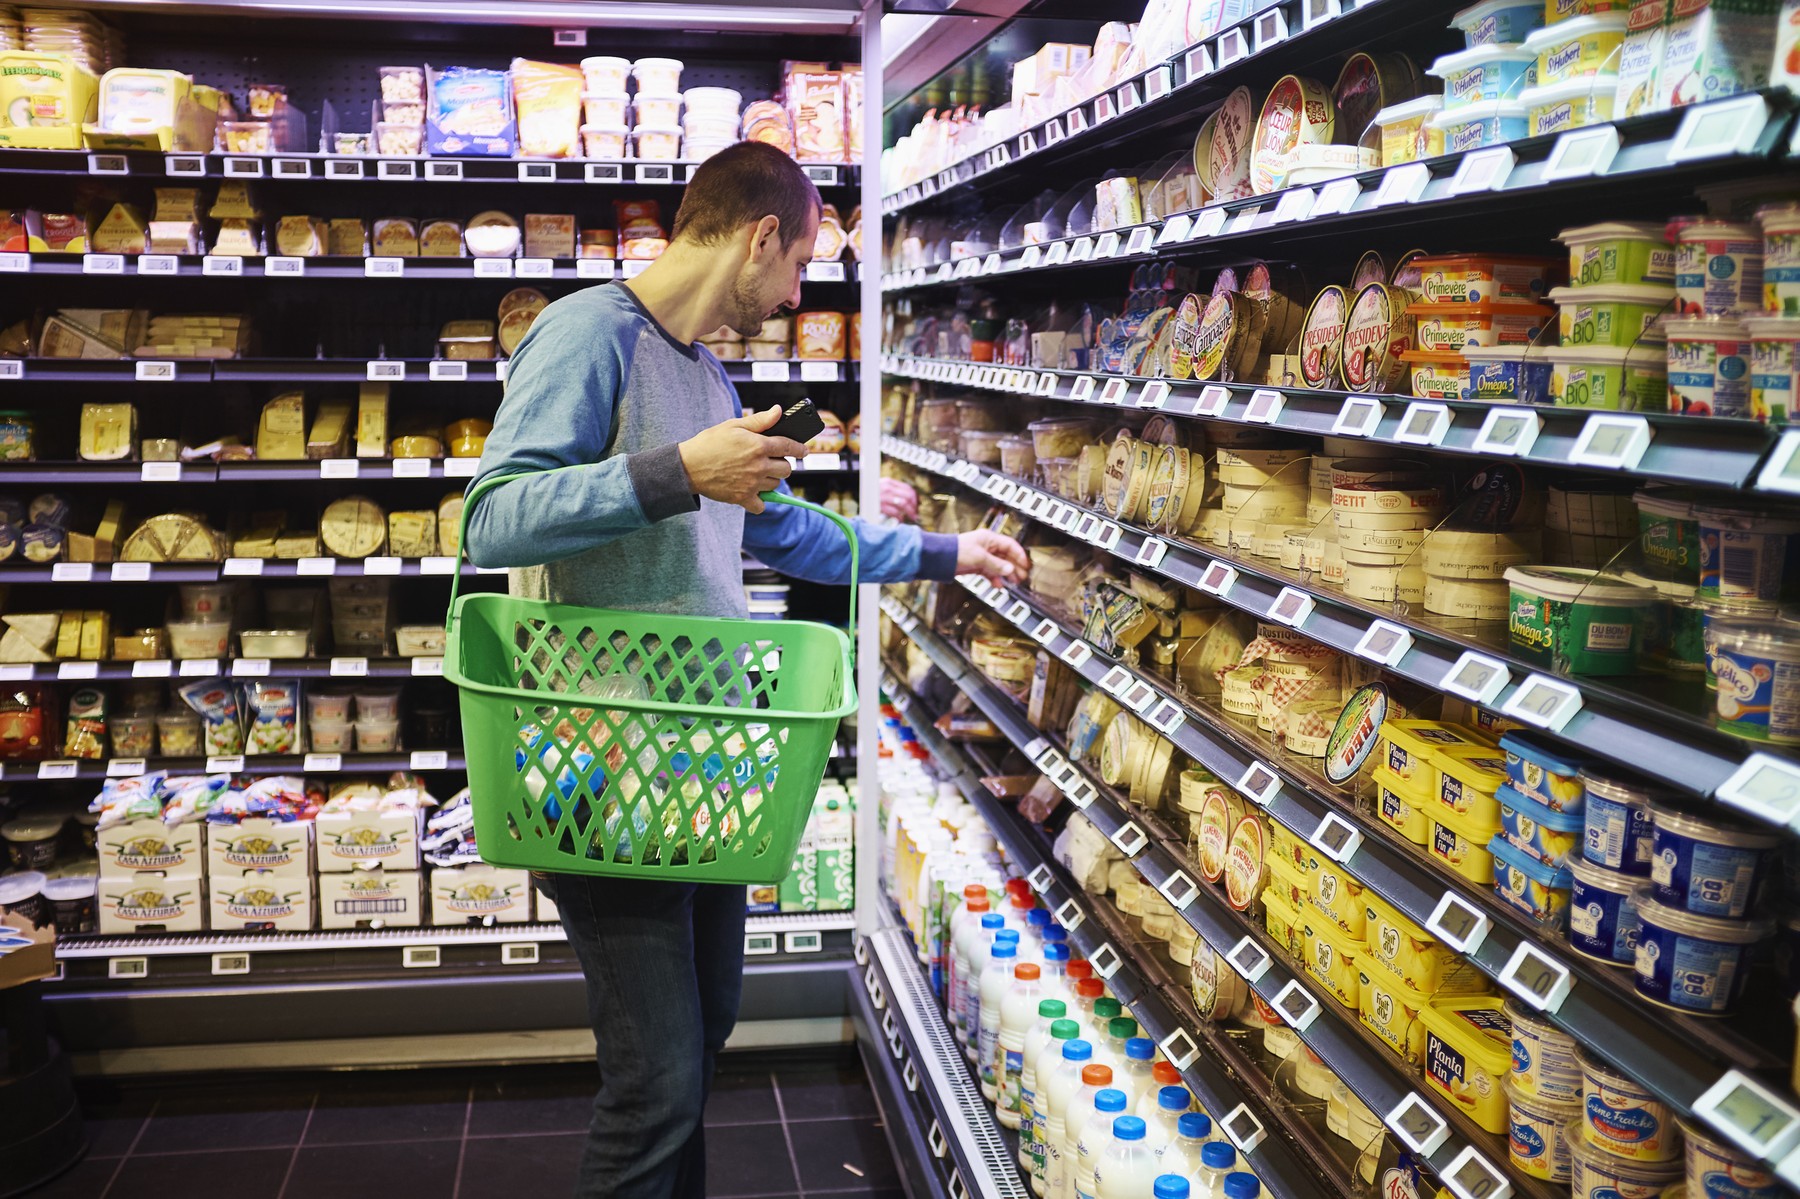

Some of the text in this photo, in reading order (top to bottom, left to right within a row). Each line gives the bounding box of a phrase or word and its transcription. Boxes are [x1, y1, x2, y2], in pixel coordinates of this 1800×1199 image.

[1582, 260, 1602, 285] BIO
[1427, 280, 1467, 296] Primevère
[1303, 323, 1344, 350] PRÉSIDENT
[1344, 322, 1389, 351] PRÉSIDENT
[1425, 328, 1465, 344] Primevère
[1573, 321, 1595, 343] BIO
[1353, 353, 1361, 369] 8
[1418, 375, 1459, 392] Primevère
[1477, 374, 1515, 395] Oméga 3
[1566, 383, 1589, 405] BIO
[0, 425, 26, 436] alakis
[1332, 493, 1367, 508] LEPETIT
[1510, 611, 1553, 648] Oméga 3
[1480, 713, 1491, 725] Fin
[1389, 742, 1407, 765] Planta
[1391, 758, 1401, 771] Fin
[1442, 774, 1462, 796] Planta
[1383, 789, 1400, 811] Planta
[1444, 789, 1454, 803] Fin
[1384, 804, 1393, 817] Fin
[1435, 823, 1456, 846] Planta
[335, 844, 398, 855] CASA AZZURRA
[1437, 839, 1447, 854] Fin
[118, 854, 182, 866] CASA AZZURRA
[226, 853, 289, 865] CASA AZZURRA
[1233, 846, 1256, 877] CAMEMBERT
[1322, 874, 1334, 890] Fruit
[1321, 888, 1332, 901] d'Or
[118, 906, 181, 917] CASA AZZURRA
[228, 905, 291, 916] CASA AZZURRA
[1382, 927, 1396, 943] Fruit
[1318, 943, 1330, 958] Fruit
[1382, 942, 1394, 956] d'Or
[1318, 956, 1329, 970] d'Or
[1192, 958, 1217, 988] PRÉSIDENT
[1532, 971, 1552, 995] 0
[1376, 992, 1389, 1008] Fruit
[1376, 1007, 1388, 1021] d'Or
[1429, 1036, 1463, 1077] Planta
[1433, 1060, 1448, 1083] Fin
[1587, 1097, 1613, 1120] Crème
[1410, 1121, 1431, 1136] 2
[1470, 1178, 1492, 1199] 0
